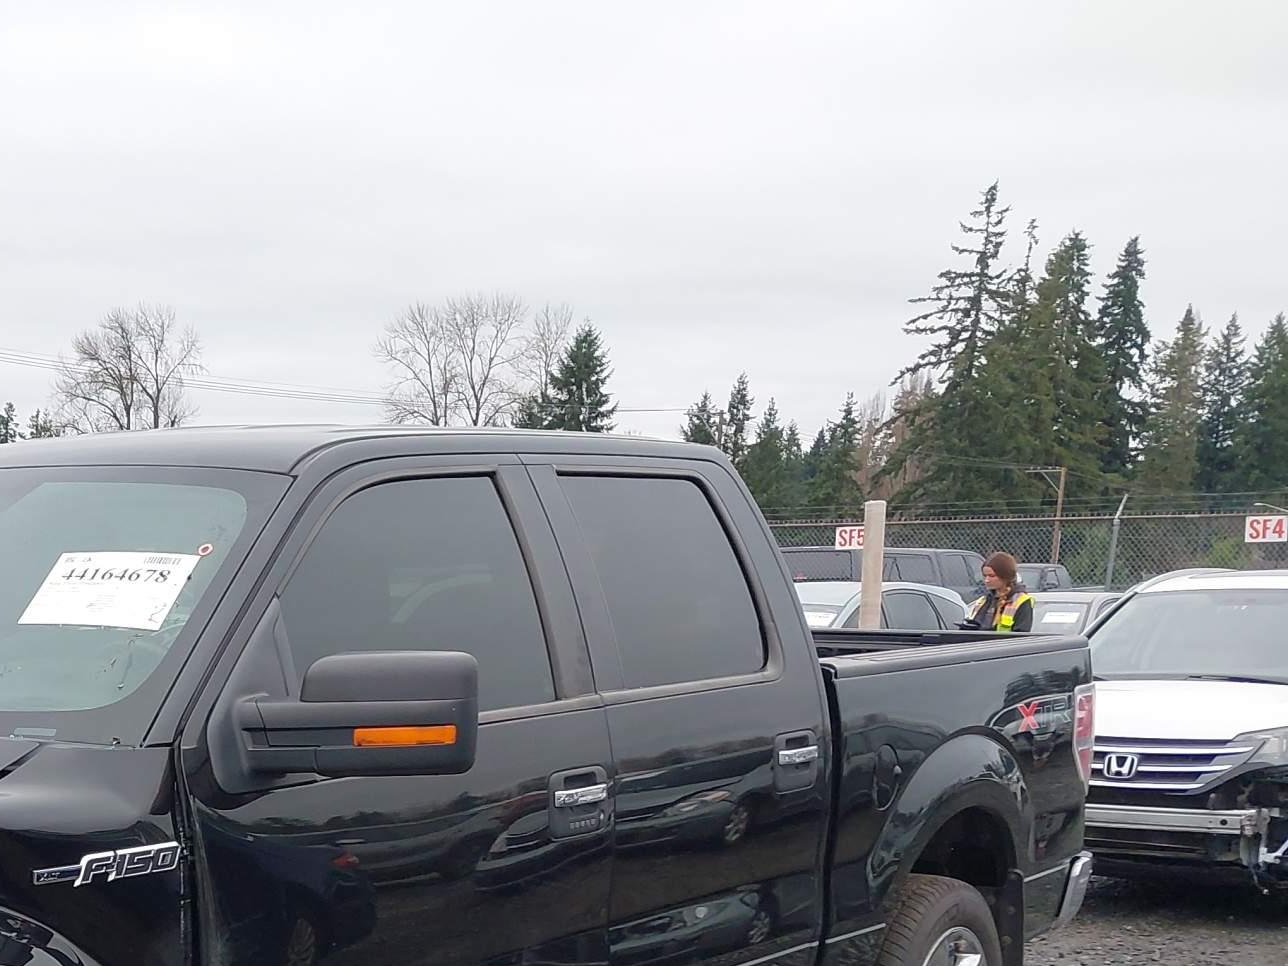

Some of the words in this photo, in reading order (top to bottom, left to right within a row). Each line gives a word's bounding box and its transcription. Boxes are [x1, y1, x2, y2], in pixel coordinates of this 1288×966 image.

[838, 528, 864, 547] SF5
[1249, 519, 1285, 539] SF4
[62, 567, 171, 584] 44164678
